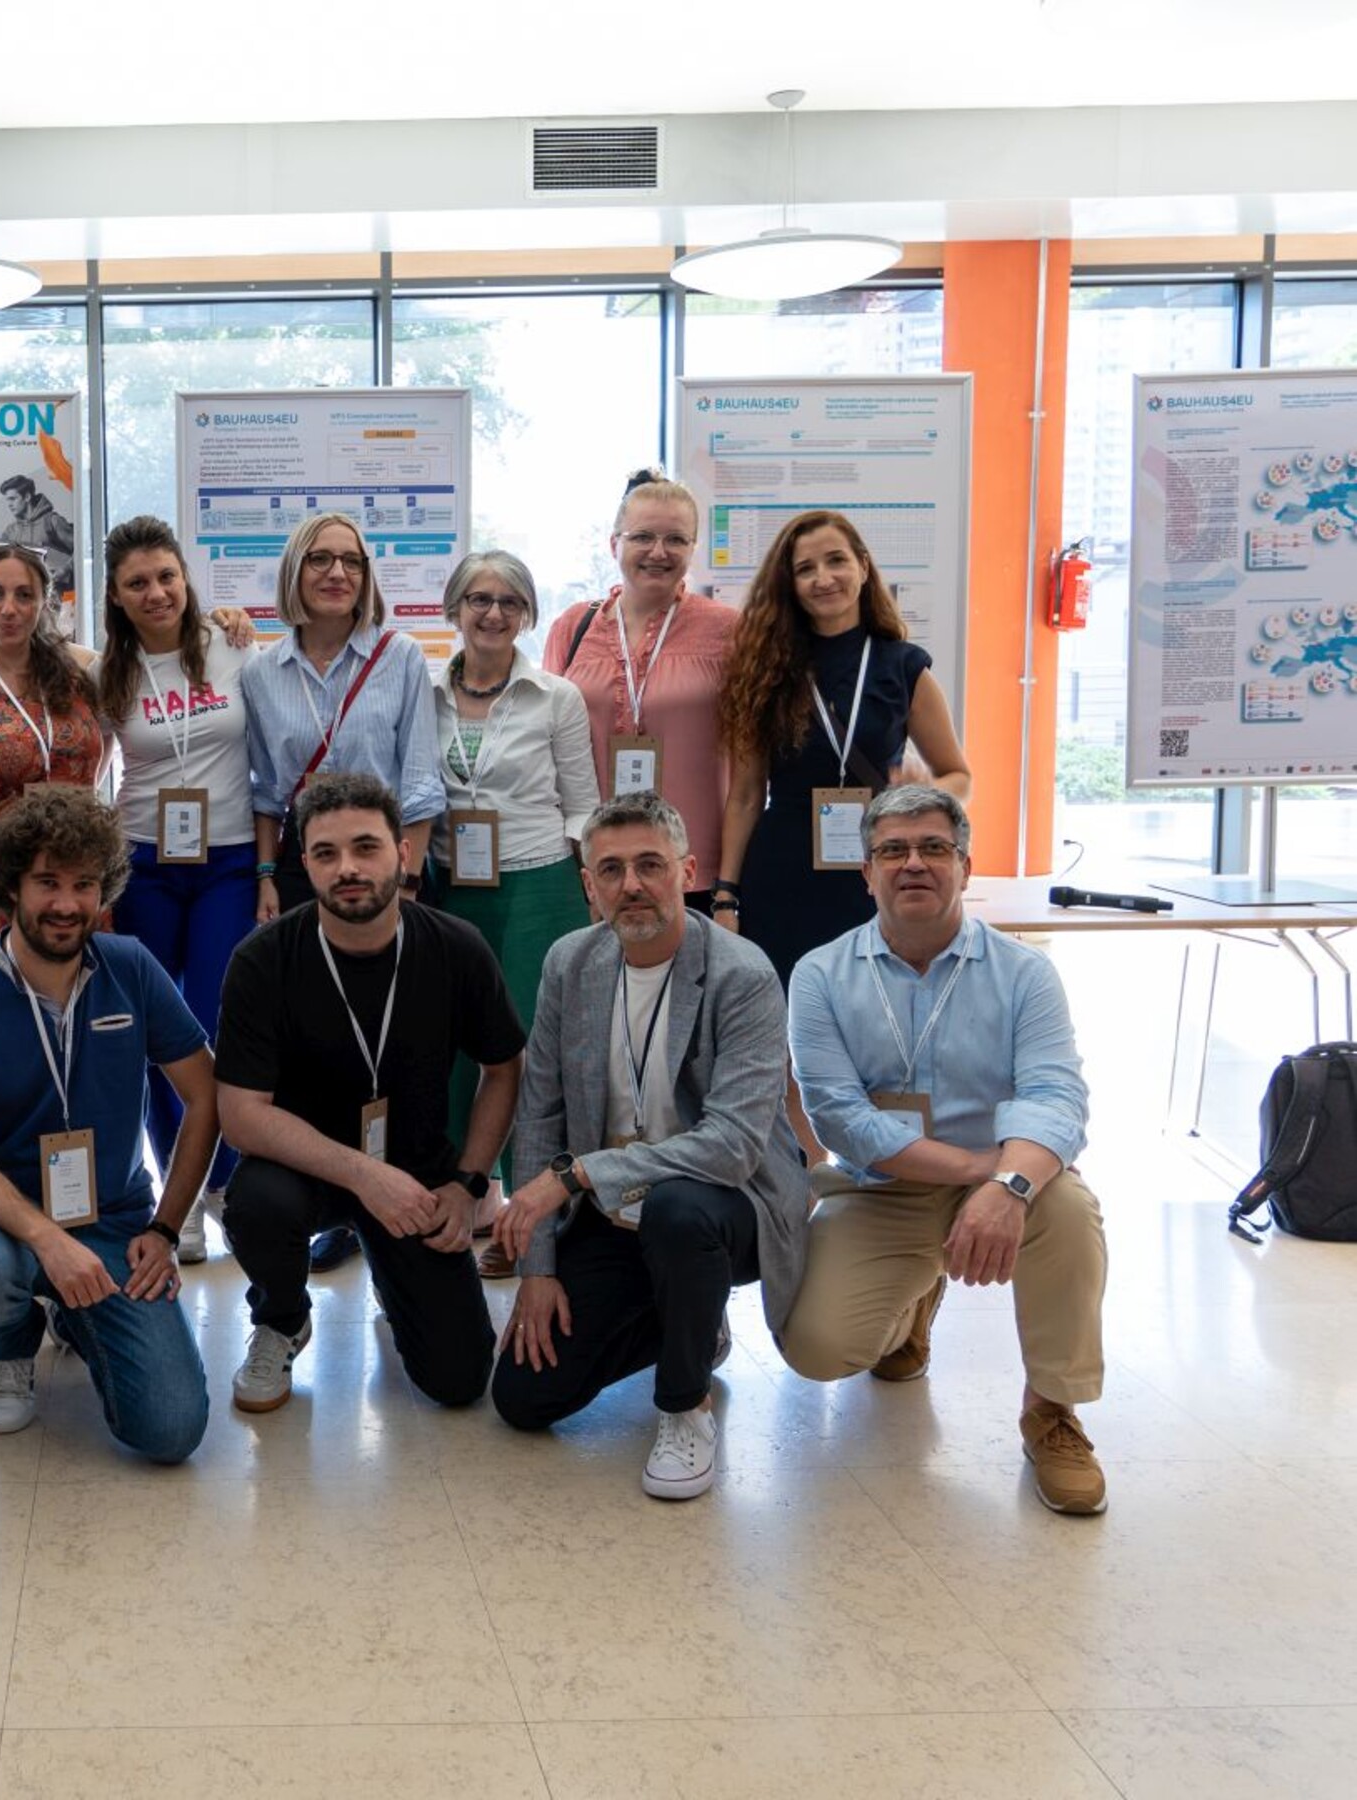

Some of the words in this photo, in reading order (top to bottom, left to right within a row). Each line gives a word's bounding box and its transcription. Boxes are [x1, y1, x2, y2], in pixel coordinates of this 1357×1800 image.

[715, 398, 800, 409] BAUHAUS4EU
[1166, 394, 1253, 408] BAUHAUS4EU
[214, 413, 298, 426] BAUHAUS4EU
